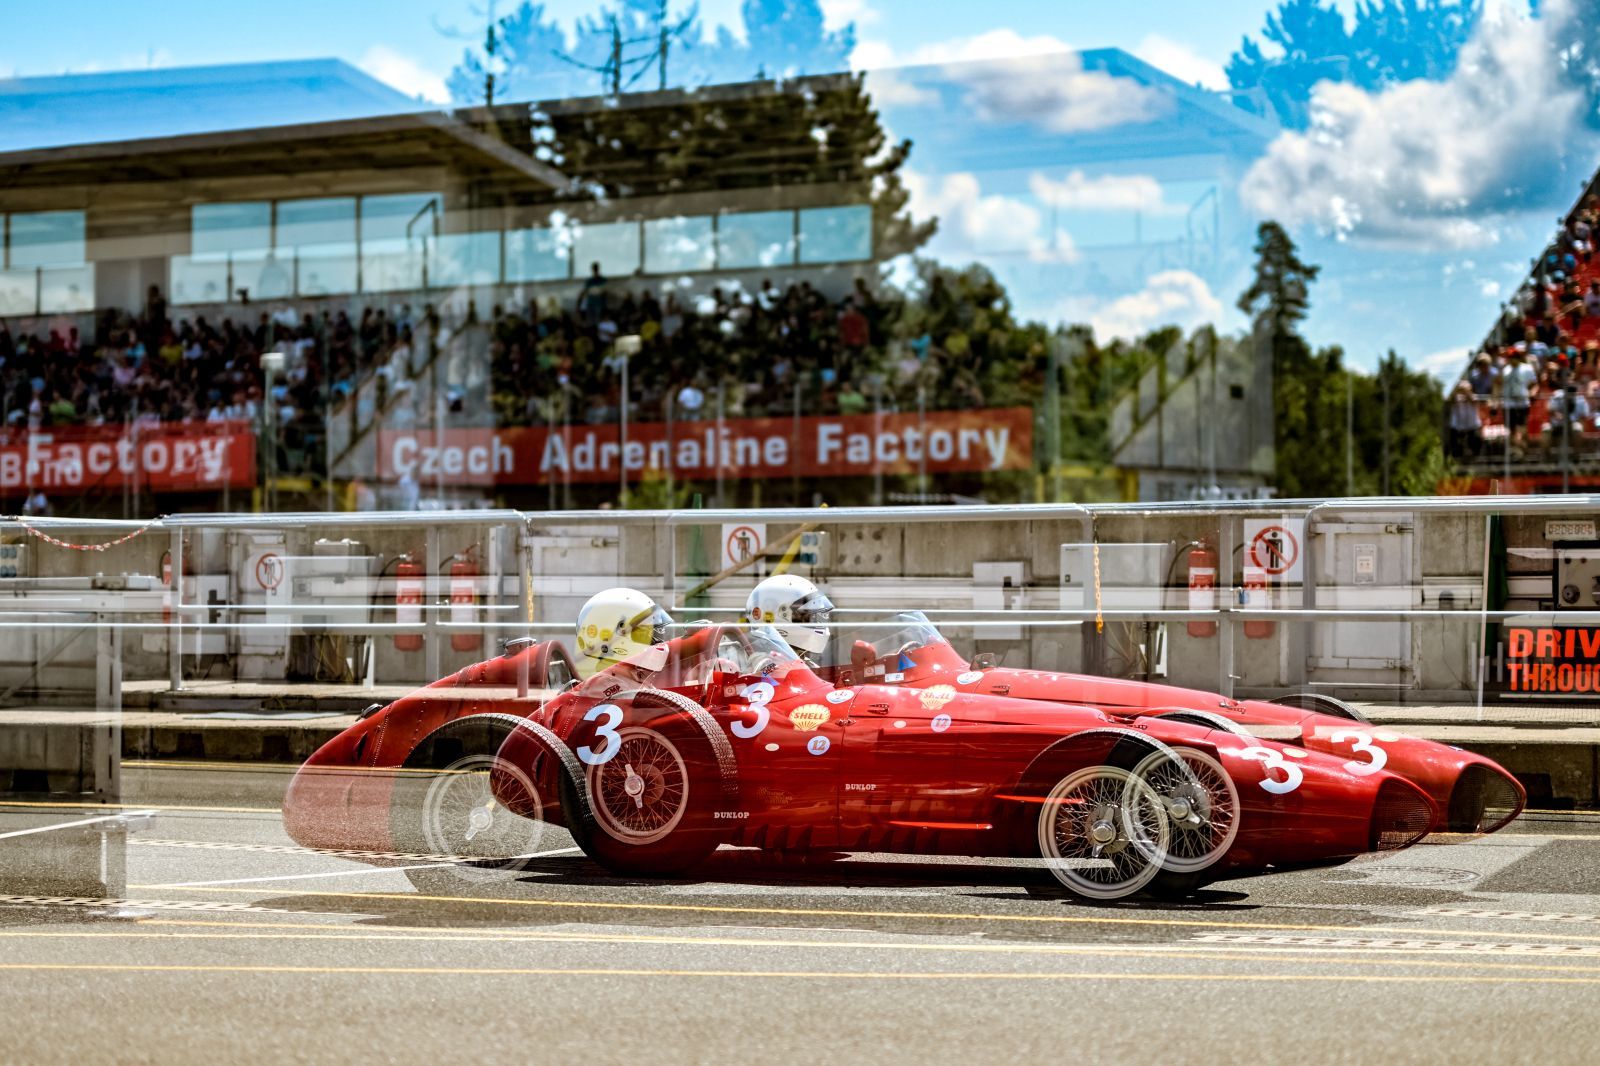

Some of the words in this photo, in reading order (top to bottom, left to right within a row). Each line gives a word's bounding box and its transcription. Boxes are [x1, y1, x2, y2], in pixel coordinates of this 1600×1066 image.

[28, 432, 230, 482] Factory
[391, 436, 514, 475] Czech
[539, 426, 788, 473] Adrenaline
[816, 423, 1010, 469] Factory
[577, 703, 624, 766] 3
[730, 682, 775, 739] 3
[793, 711, 825, 721] SHELL
[812, 739, 827, 751] 12
[1331, 730, 1388, 777] 3
[845, 783, 877, 791] DUNLOP
[1240, 746, 1304, 795] 3
[714, 811, 750, 819] DUNLOP
